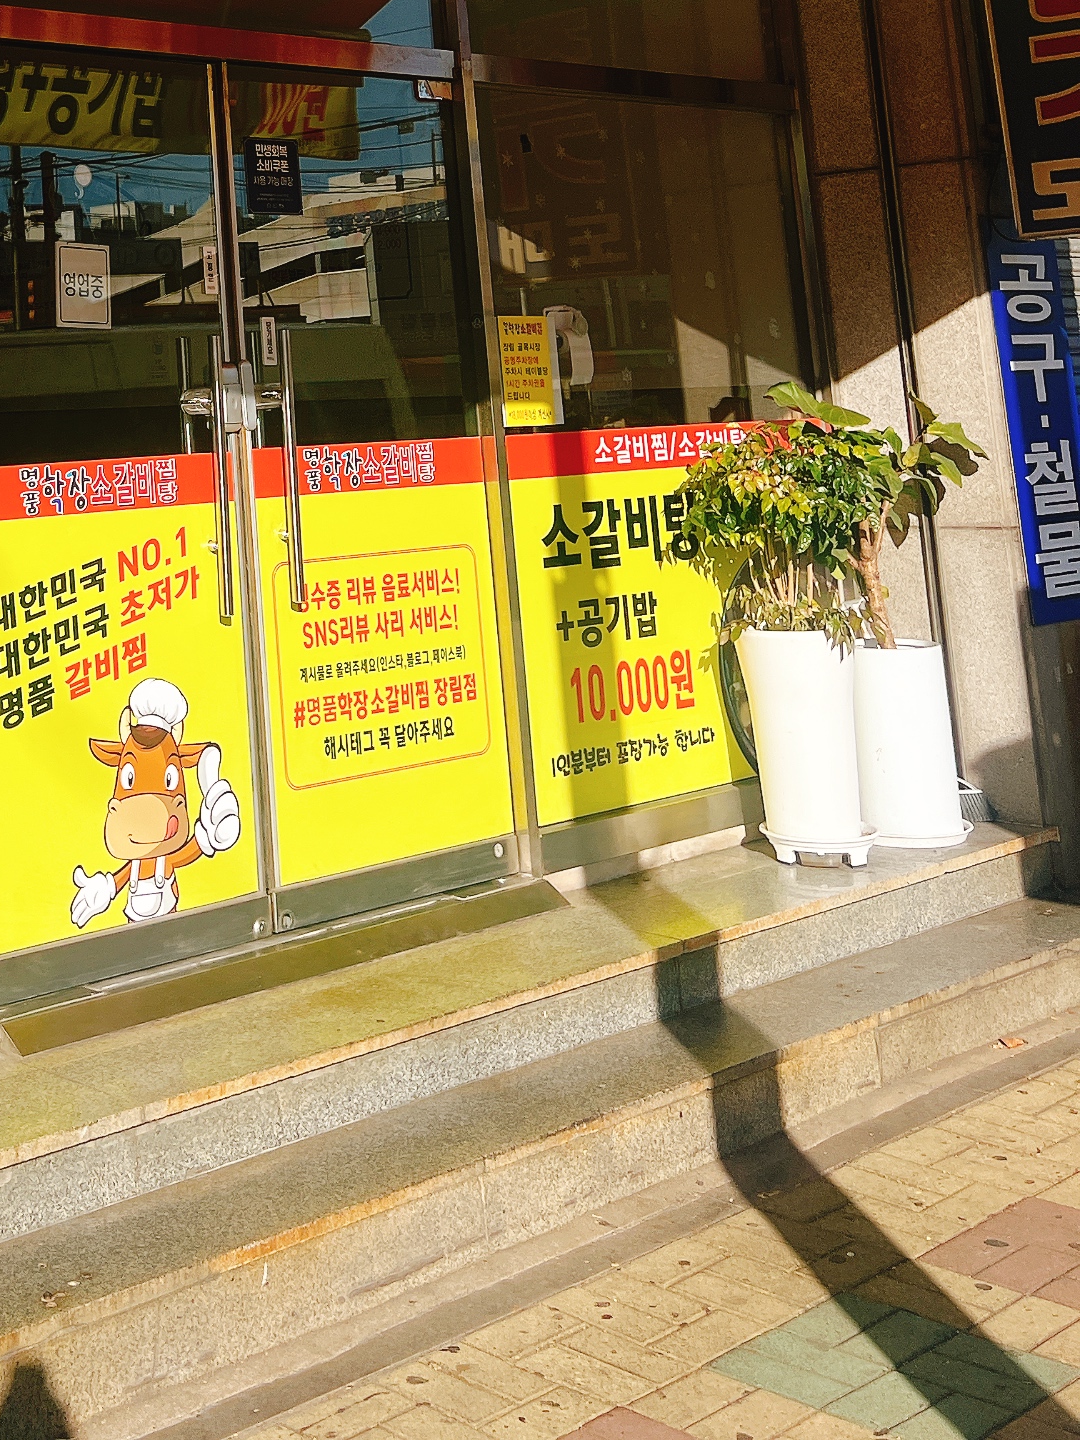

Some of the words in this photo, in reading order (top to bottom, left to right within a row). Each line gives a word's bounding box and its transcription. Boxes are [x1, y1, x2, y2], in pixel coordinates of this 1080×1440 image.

[255, 143, 288, 158] 민생회복
[256, 159, 290, 173] 소비쿠폰
[63, 272, 104, 299] 영업중
[118, 527, 187, 582] NO.1
[121, 566, 200, 627] 초저가
[347, 576, 376, 605] 리뷰
[382, 568, 460, 602] 음료서비스!
[303, 614, 370, 649] SNS리뷰
[375, 610, 404, 639] 사리
[410, 604, 458, 635] 서비스!
[556, 591, 658, 648] +공기밥
[65, 633, 147, 700] 갈비찜
[571, 649, 696, 723] 10.000원
[434, 673, 477, 706] 장림점
[379, 727, 390, 749] 꼭
[395, 716, 455, 747] 달아주세요
[551, 747, 611, 778] 1인분부터
[675, 727, 715, 752] 합니다
